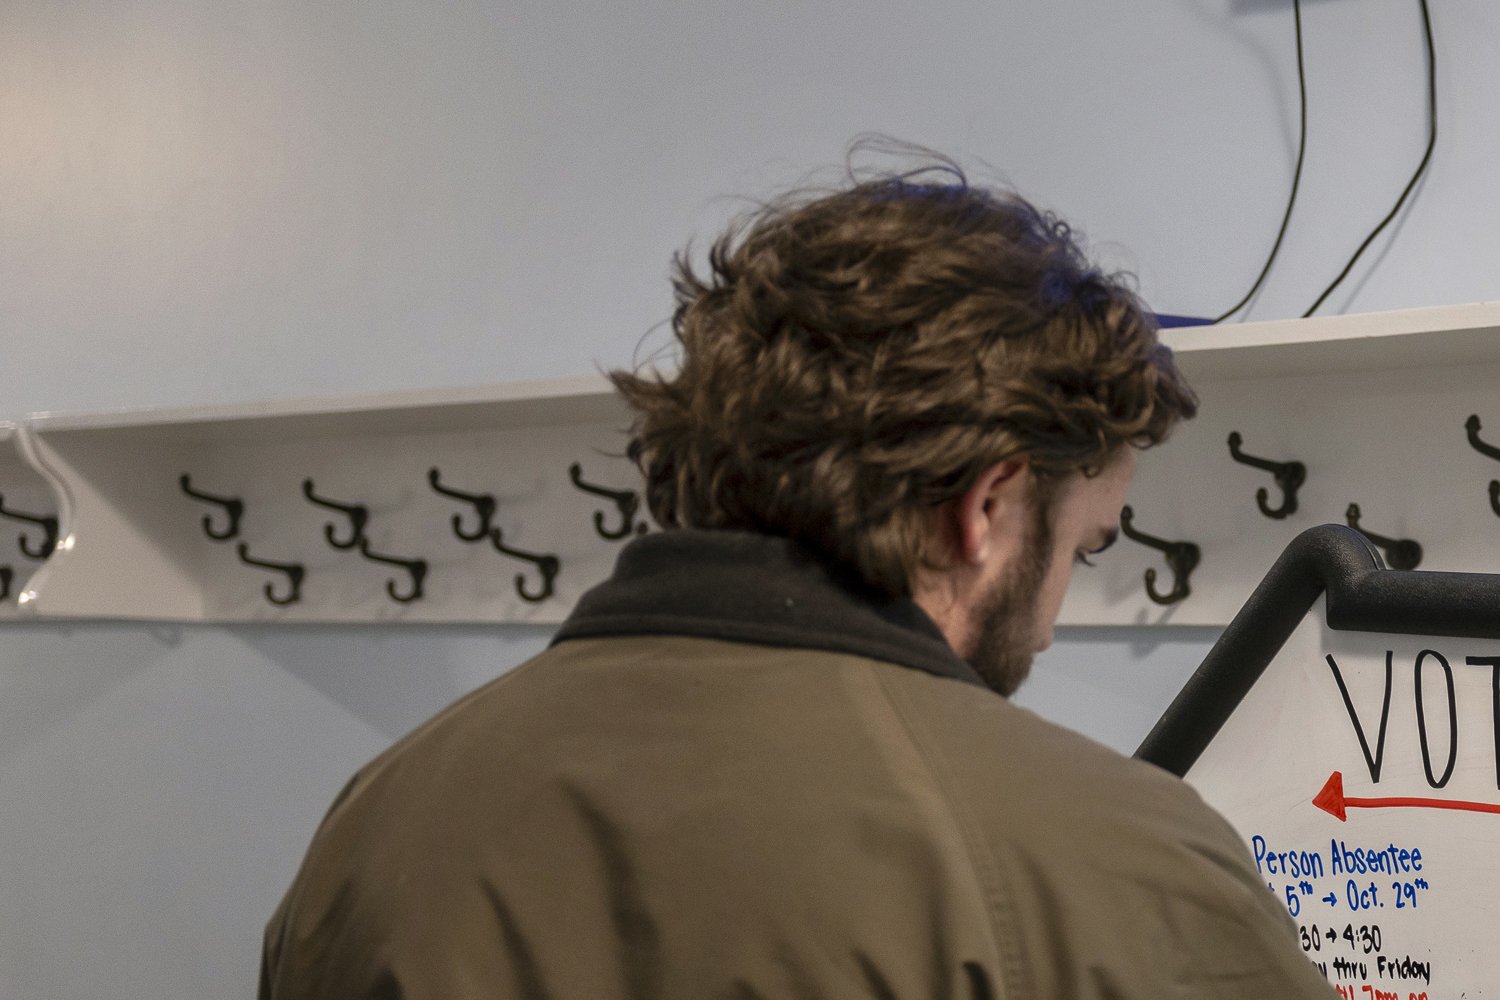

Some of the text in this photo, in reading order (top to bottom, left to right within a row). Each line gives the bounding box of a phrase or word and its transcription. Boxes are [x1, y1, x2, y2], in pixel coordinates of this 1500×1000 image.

[1252, 835, 1422, 878] Person Absentee
[1347, 879, 1384, 911] Oct.
[1392, 878, 1429, 908] 29th
[1343, 923, 1381, 954] 4:30
[1333, 957, 1367, 980] thru
[1377, 955, 1431, 986] Friday
